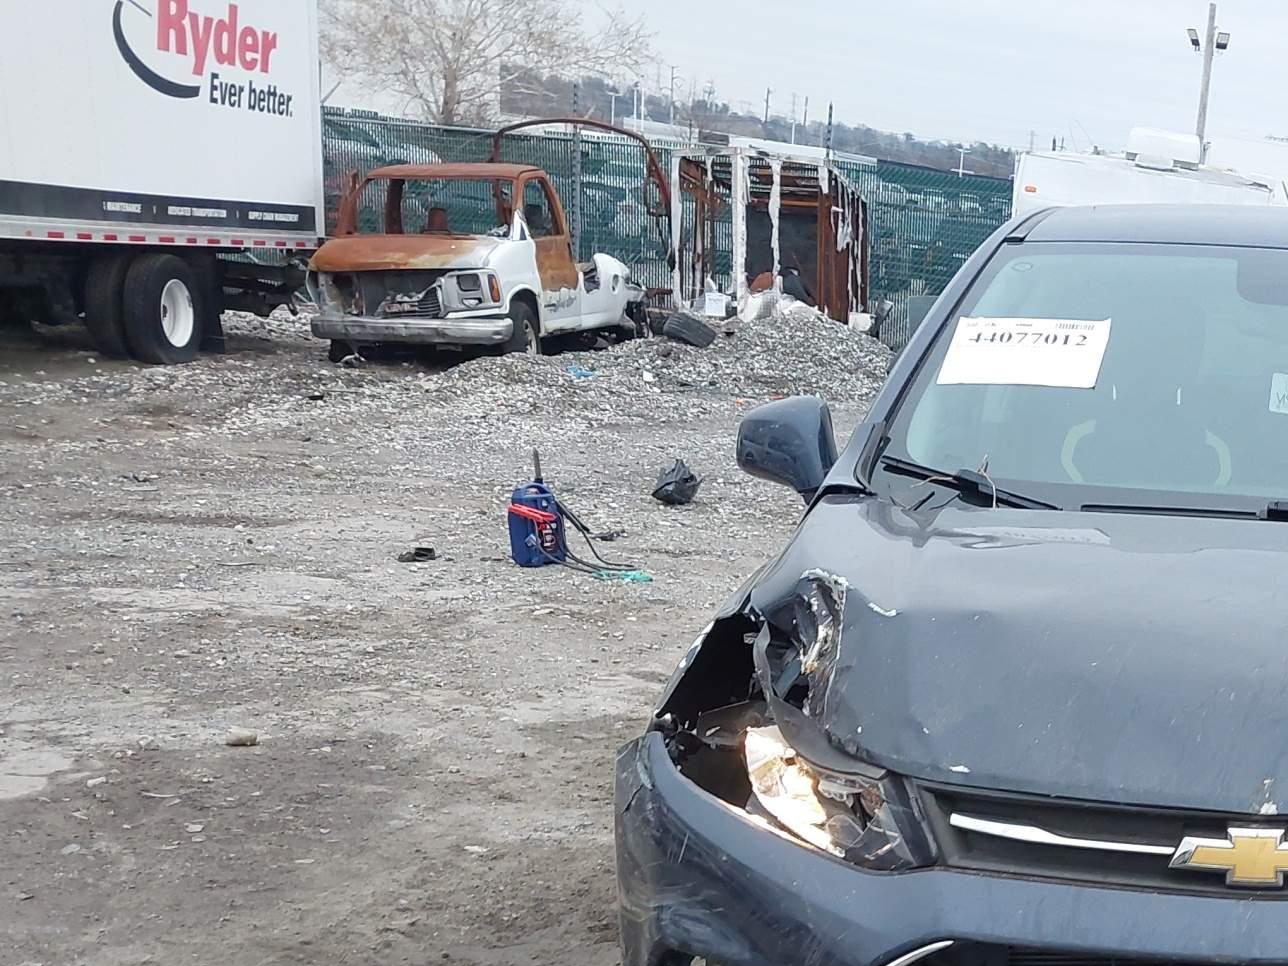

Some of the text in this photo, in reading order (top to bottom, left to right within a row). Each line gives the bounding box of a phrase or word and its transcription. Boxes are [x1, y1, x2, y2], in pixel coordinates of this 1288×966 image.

[157, 0, 277, 76] Ryder
[209, 72, 293, 117] Ever better.
[968, 331, 1089, 346] 44077012
